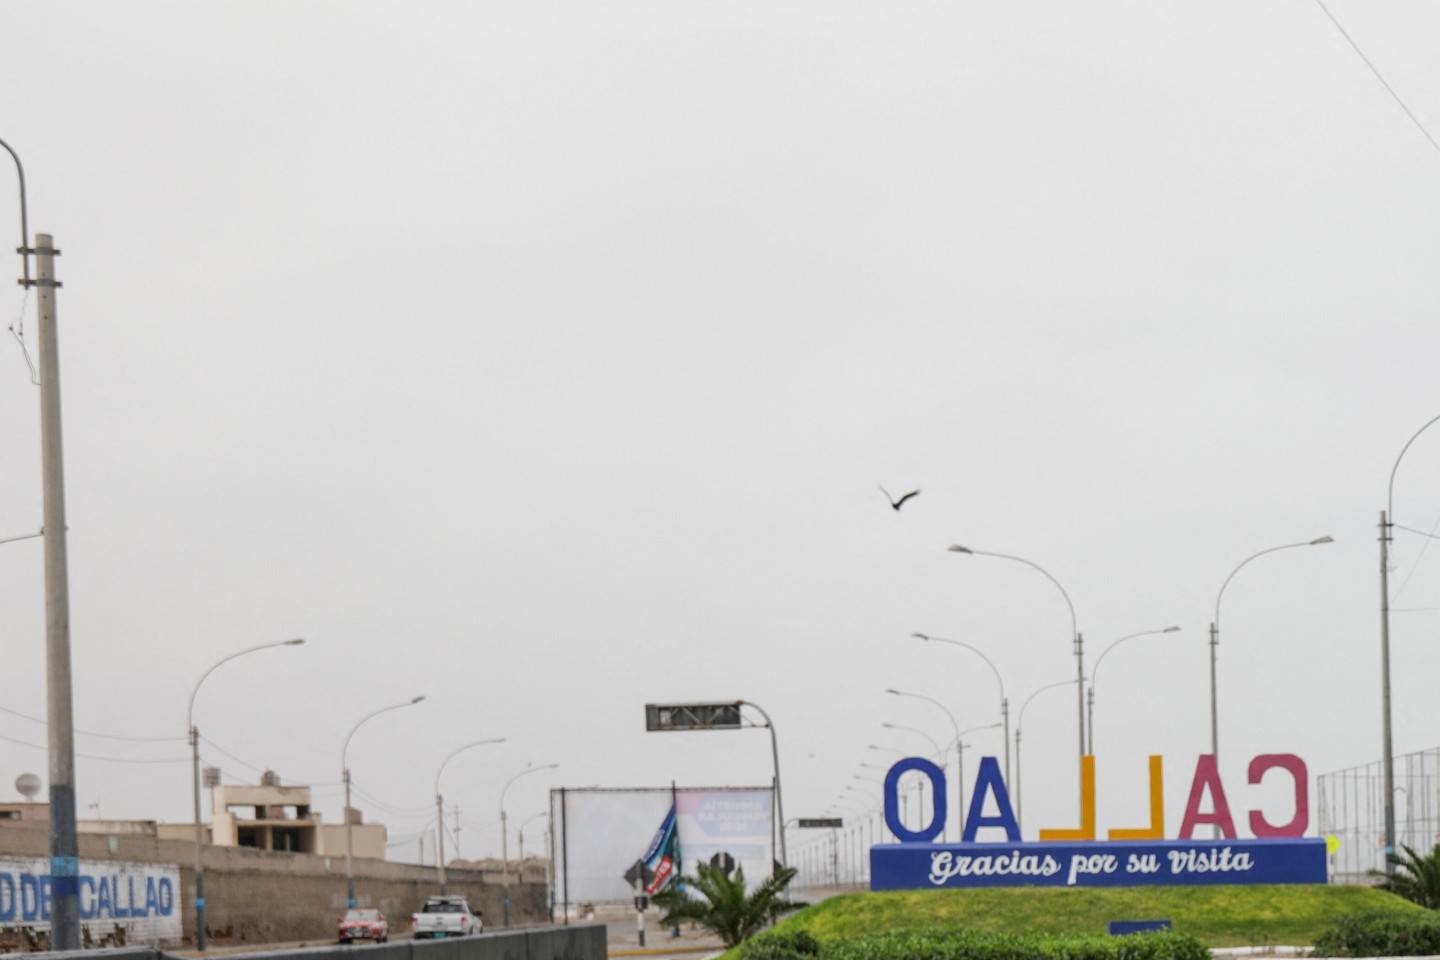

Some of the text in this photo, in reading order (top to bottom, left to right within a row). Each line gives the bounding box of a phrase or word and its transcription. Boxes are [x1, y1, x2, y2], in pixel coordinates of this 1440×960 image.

[929, 851, 1062, 885] Gracias
[1068, 853, 1118, 885] por
[1127, 854, 1161, 874] su
[79, 874, 174, 919] CALLAO
